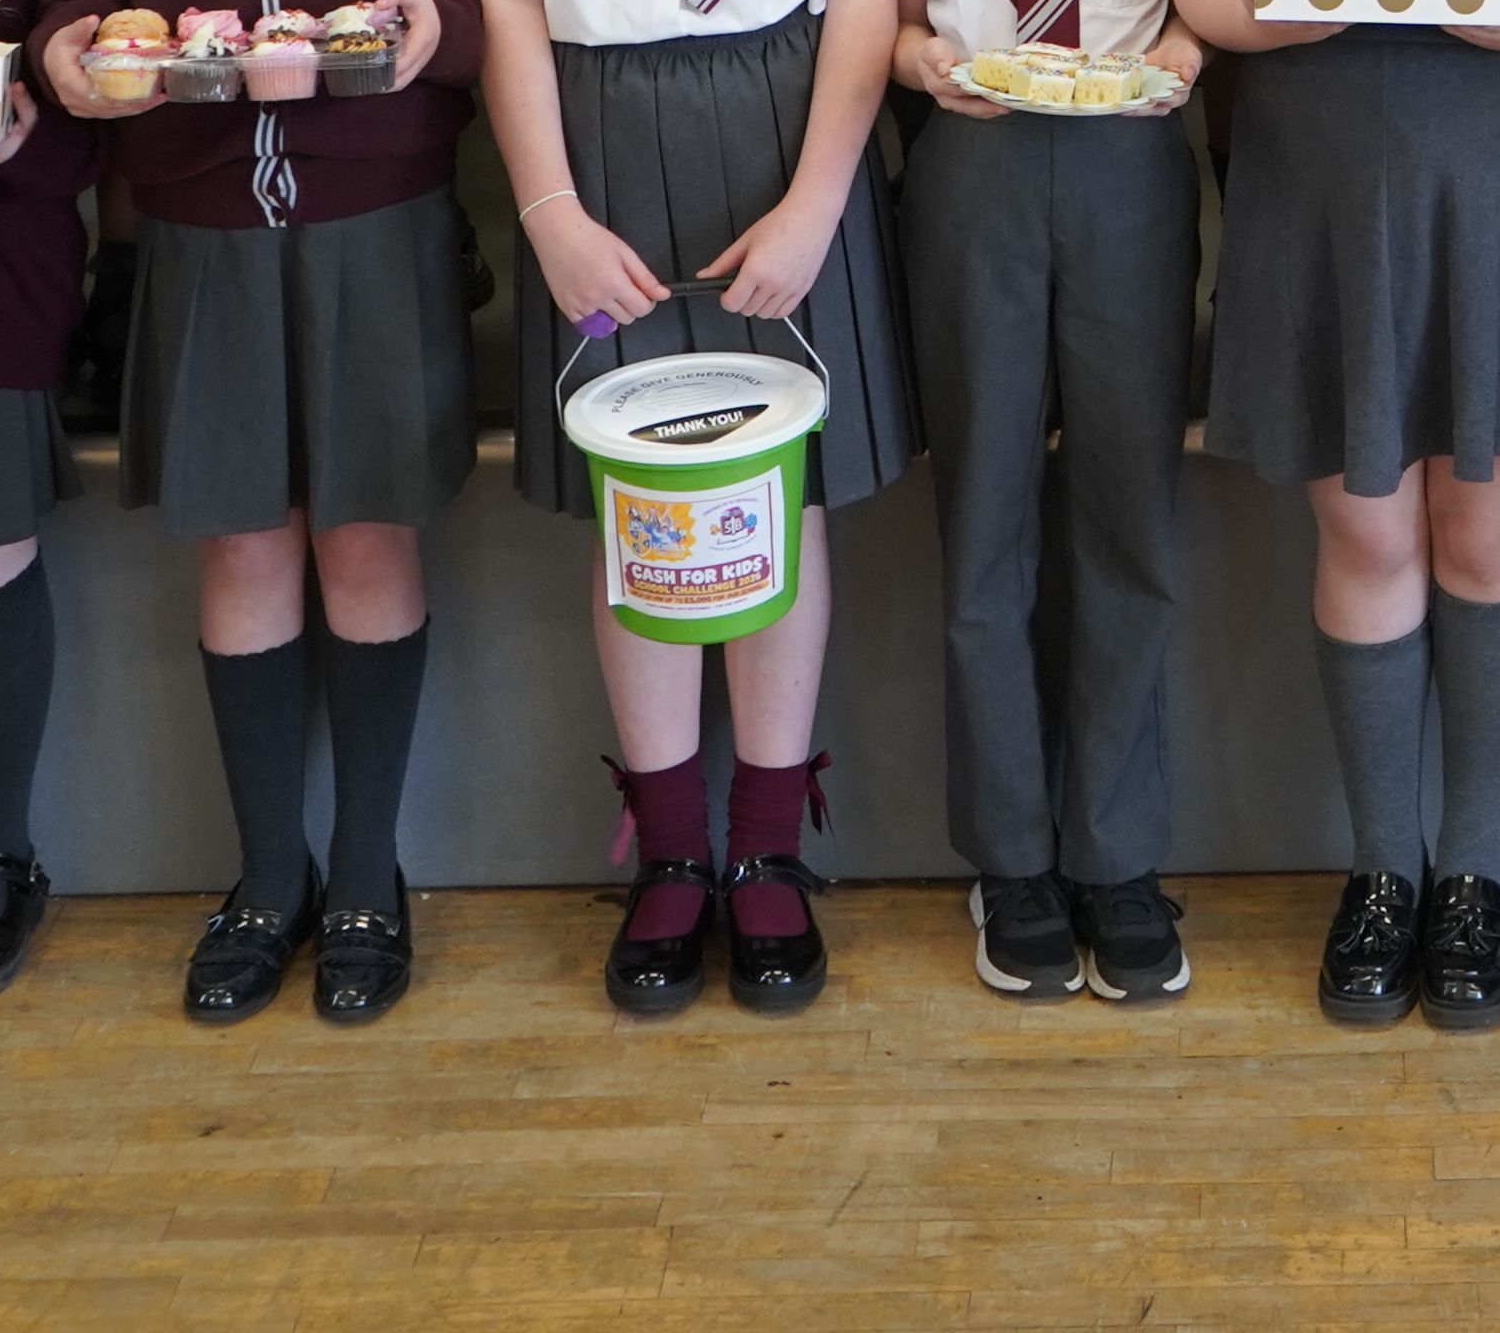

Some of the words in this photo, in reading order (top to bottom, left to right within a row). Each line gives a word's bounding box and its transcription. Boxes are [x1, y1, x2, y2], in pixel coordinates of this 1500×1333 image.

[611, 387, 643, 413] PLEASE
[640, 376, 672, 388] GIVE
[675, 371, 764, 386] GENEROUSLY
[654, 419, 708, 438] THANK
[707, 410, 744, 428] YOU!
[631, 564, 676, 585] CASH
[680, 568, 718, 586] FOR
[721, 556, 763, 581] KIDS
[634, 579, 669, 594] SCHOOL
[672, 580, 736, 594] CHALLENGE
